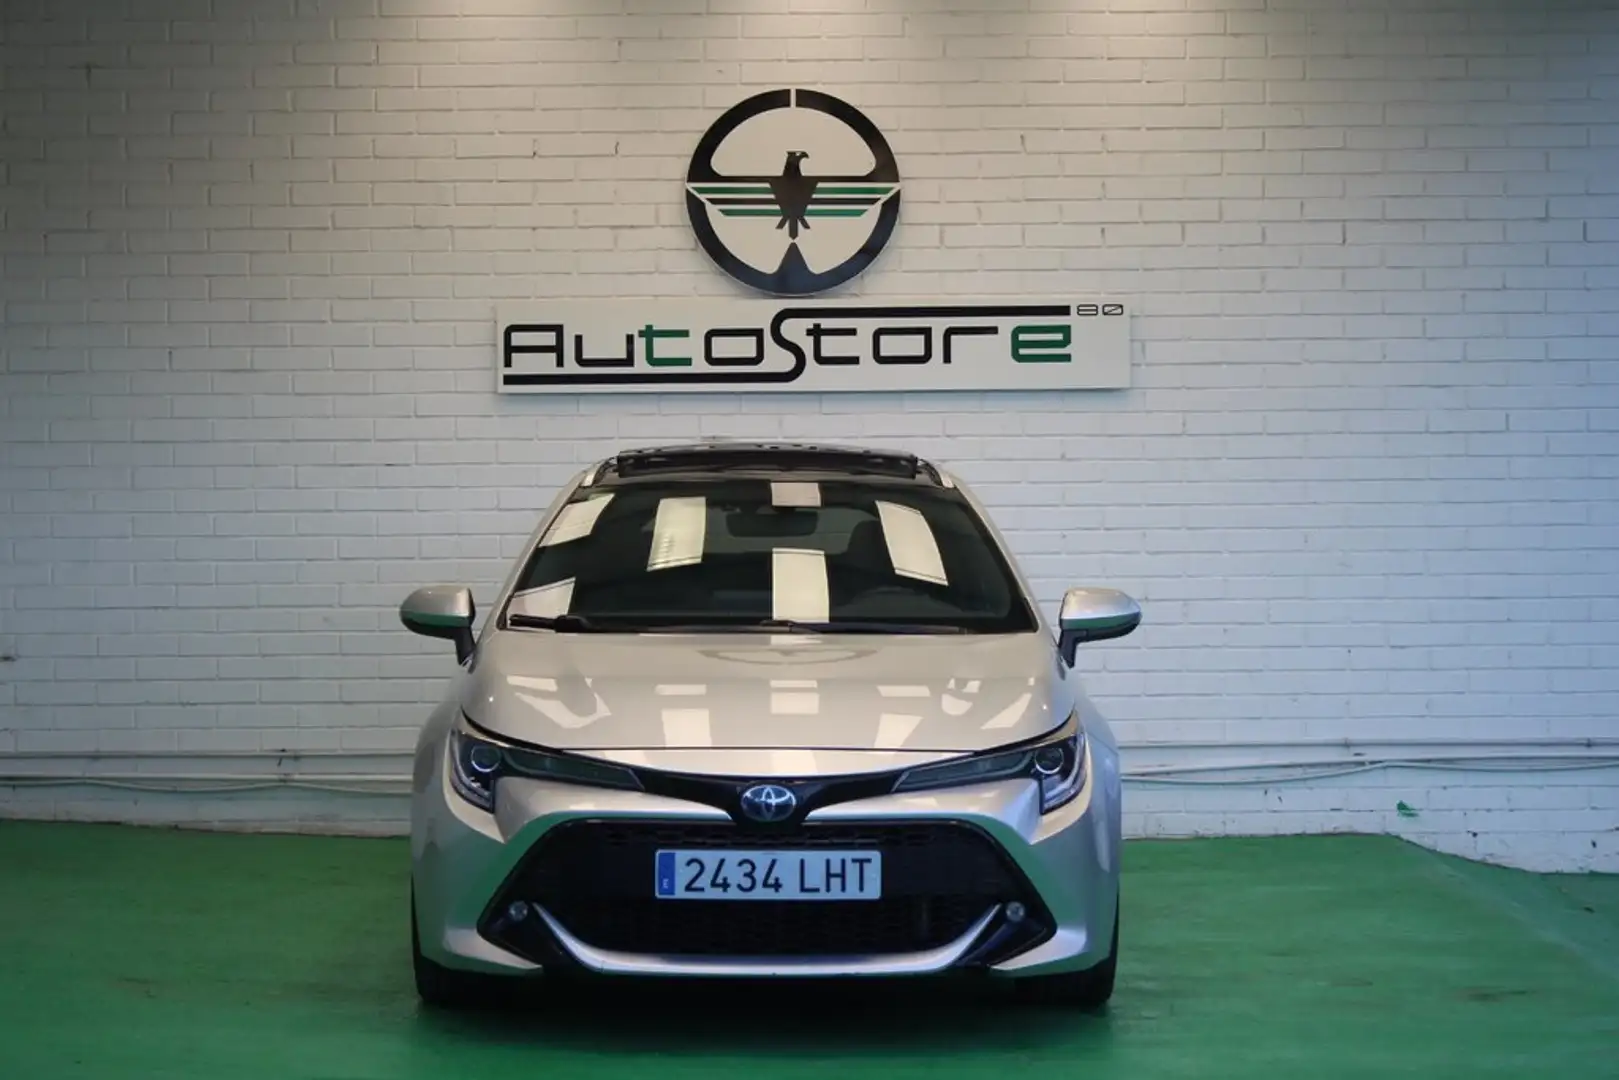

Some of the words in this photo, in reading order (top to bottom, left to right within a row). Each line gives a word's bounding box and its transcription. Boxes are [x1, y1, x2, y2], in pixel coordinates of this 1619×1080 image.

[503, 305, 1072, 385] AutoStore
[684, 858, 783, 893] 2434
[799, 858, 872, 893] LHT
